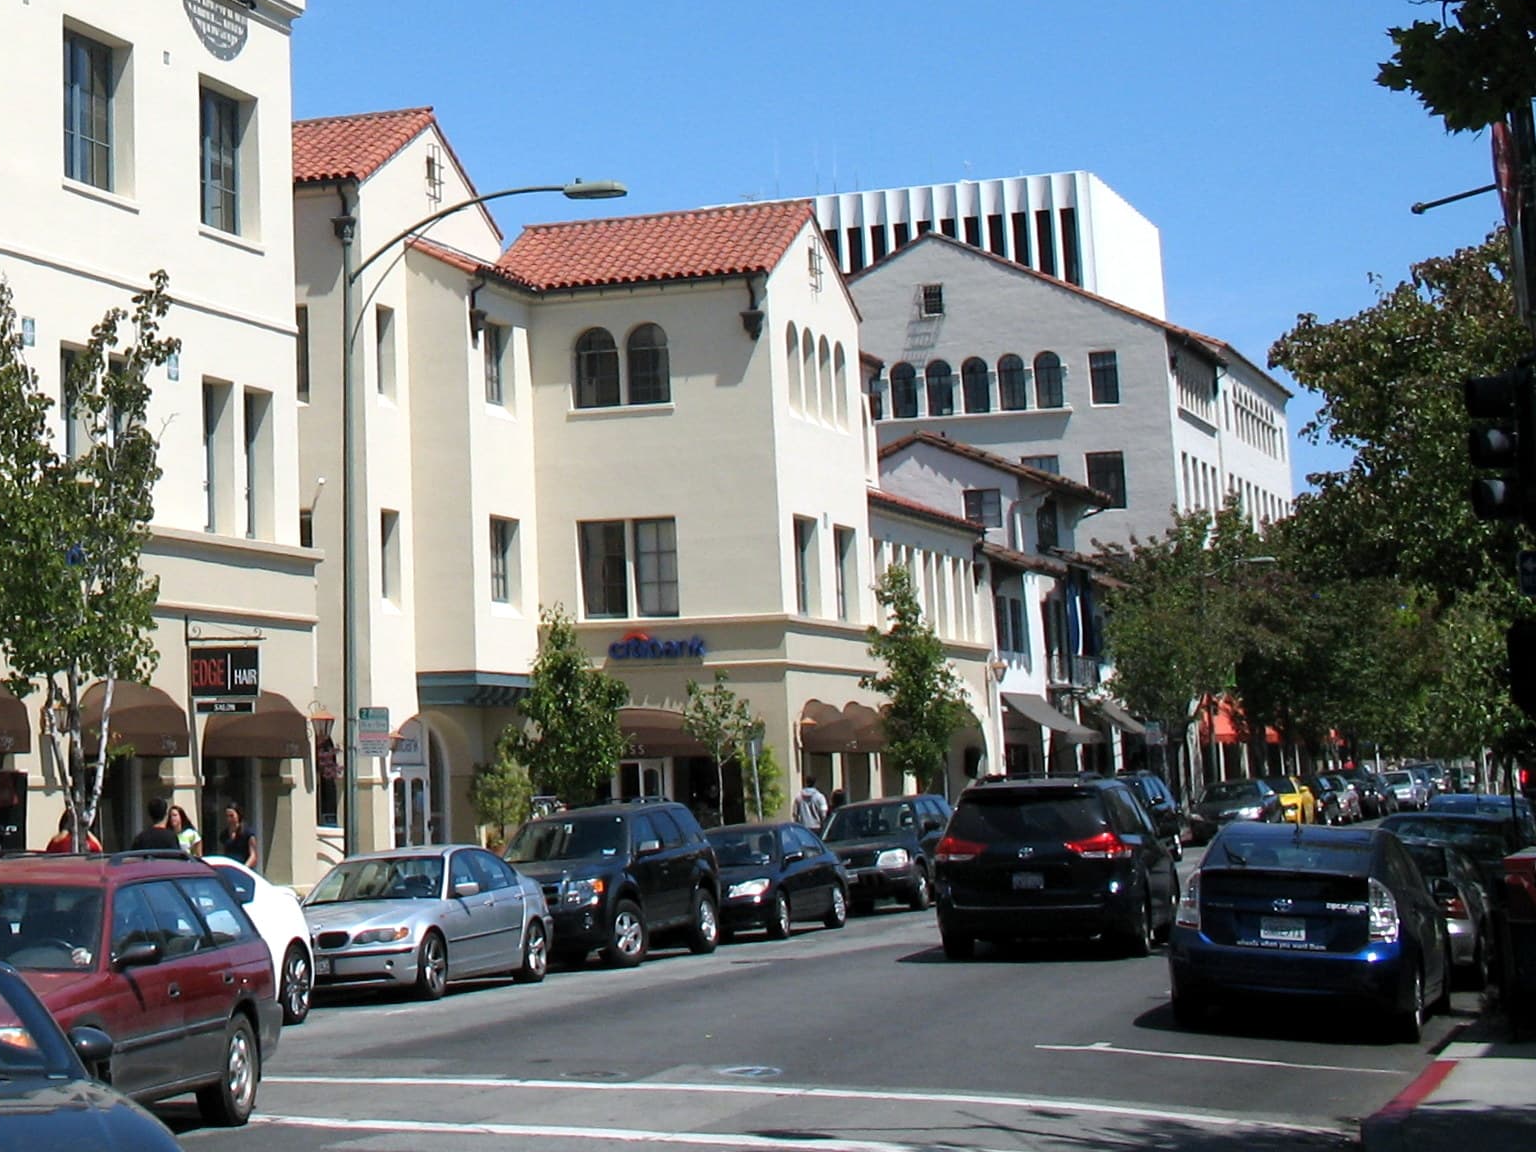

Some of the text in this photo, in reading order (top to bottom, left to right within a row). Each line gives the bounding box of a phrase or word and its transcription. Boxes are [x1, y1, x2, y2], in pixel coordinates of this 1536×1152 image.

[608, 635, 707, 660] citibank
[192, 658, 257, 686] EDGE HAIR
